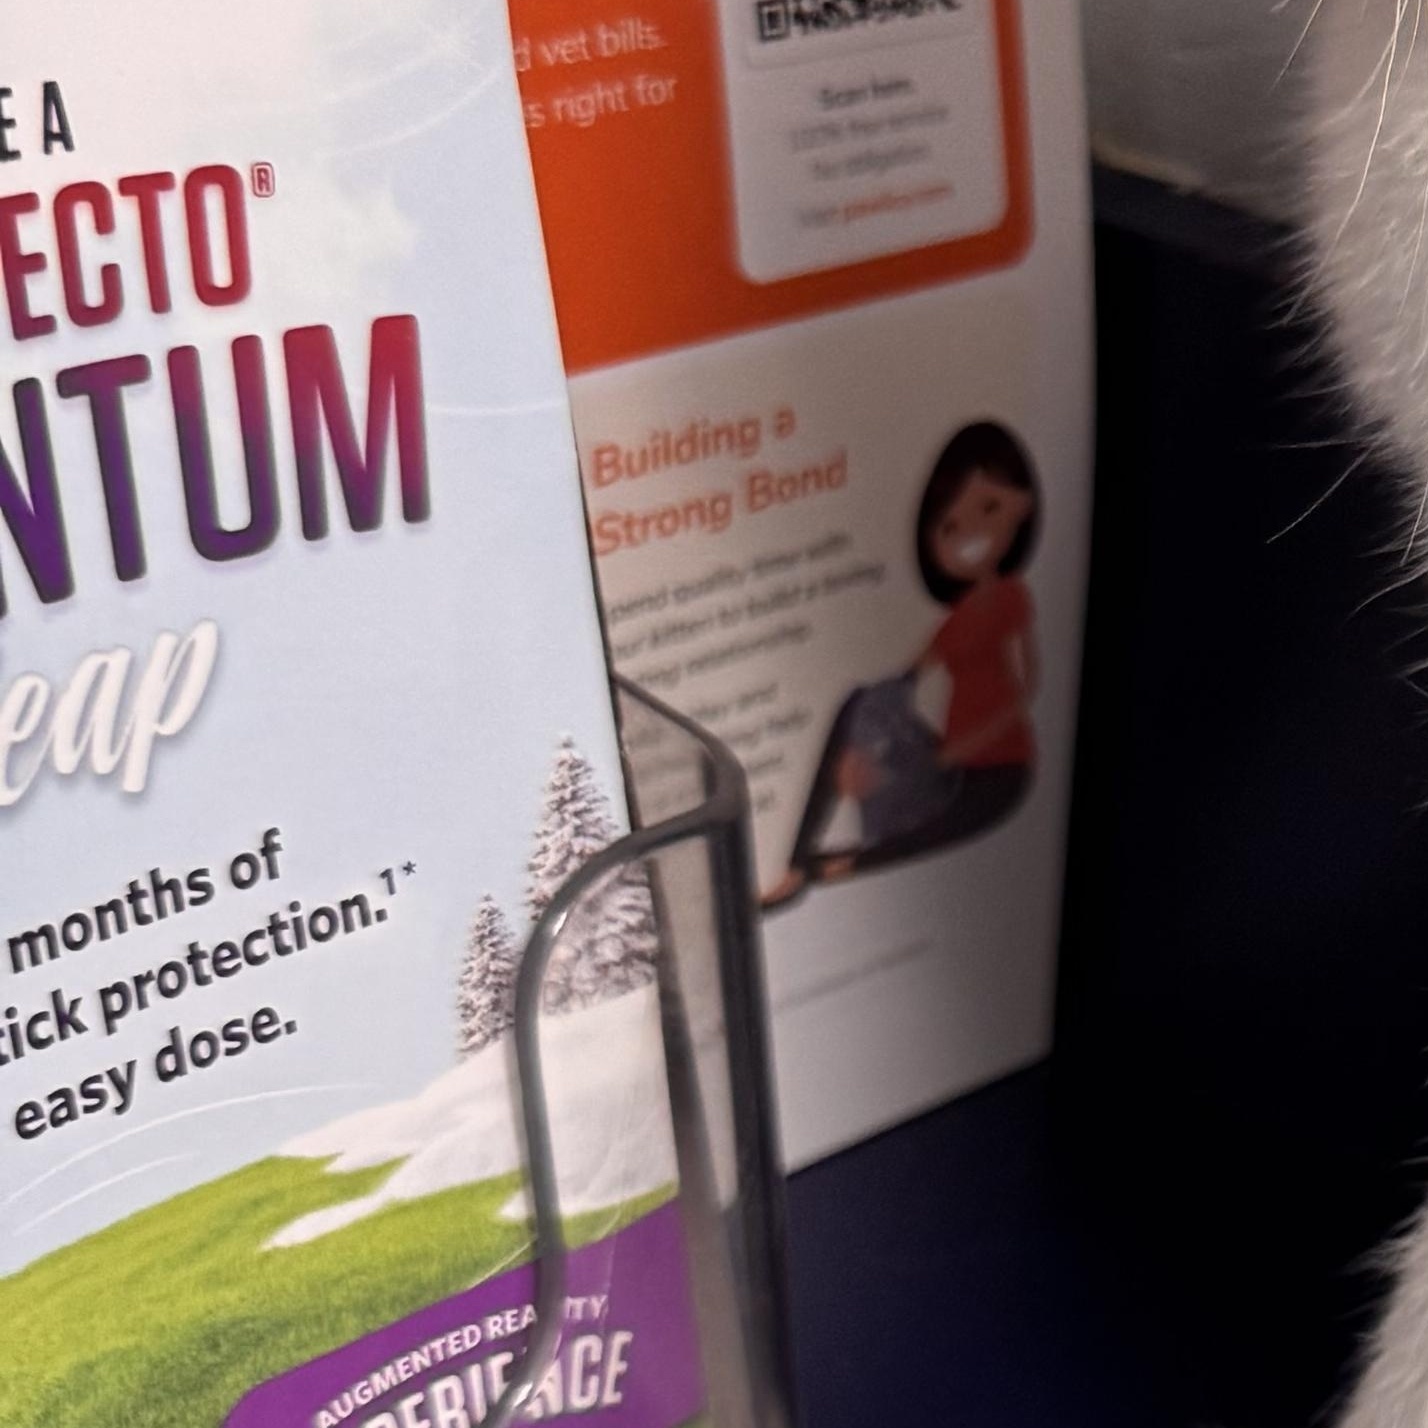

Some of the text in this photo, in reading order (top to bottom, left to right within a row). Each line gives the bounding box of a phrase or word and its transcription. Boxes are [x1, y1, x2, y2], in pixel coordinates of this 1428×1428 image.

[539, 28, 592, 66] vet
[43, 80, 75, 155] A
[552, 81, 629, 127] right
[633, 74, 679, 106] for
[590, 405, 797, 490] Building a
[593, 444, 849, 557] Strong Bond
[7, 826, 284, 973] months of
[14, 1005, 298, 1141] easy dose.
[485, 1294, 609, 1343] REAITY
